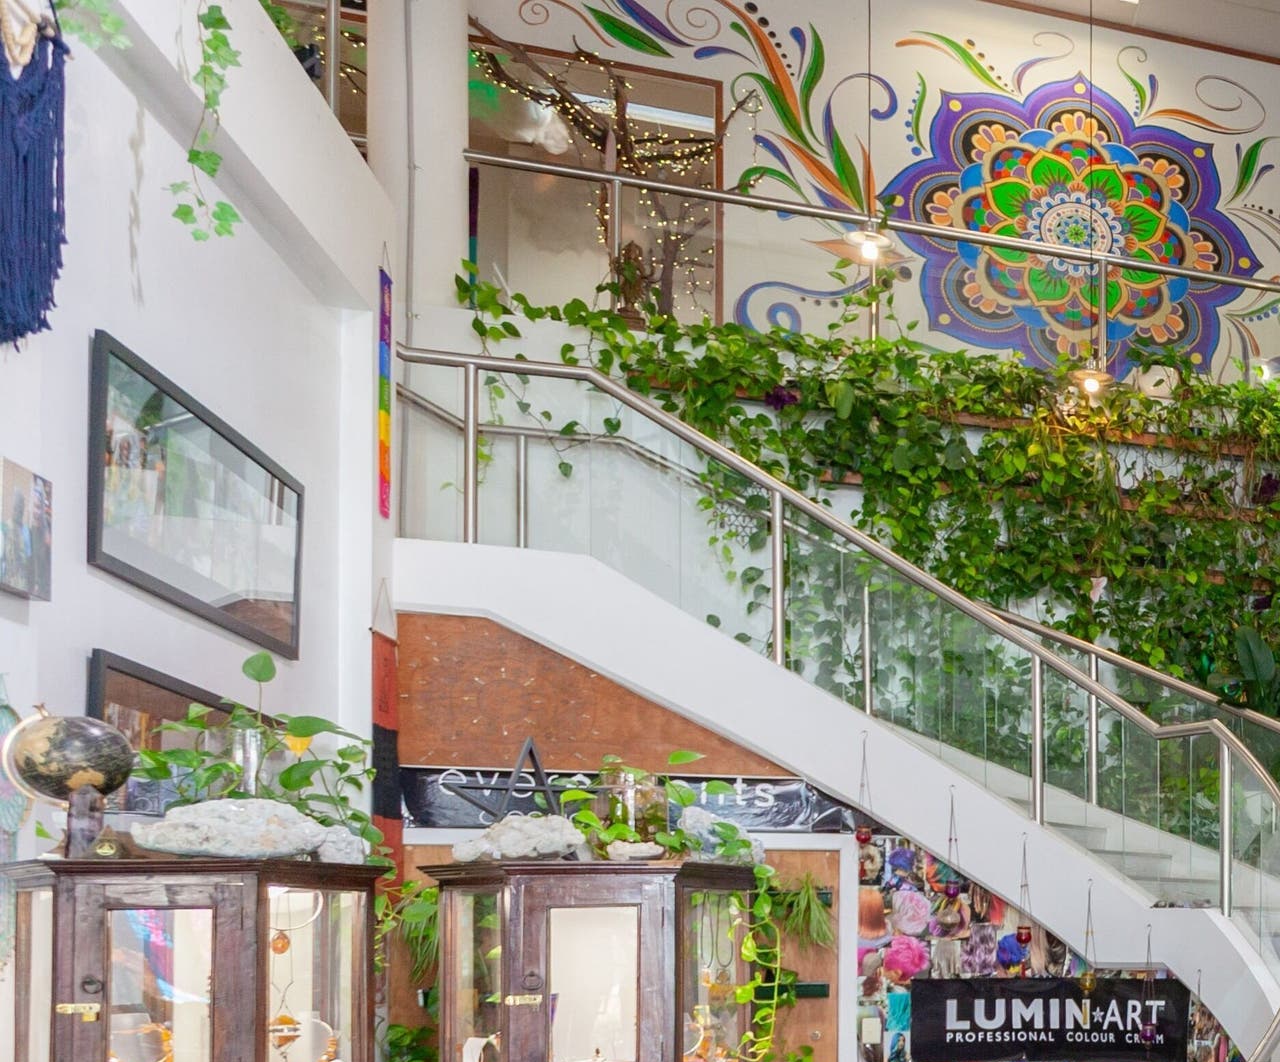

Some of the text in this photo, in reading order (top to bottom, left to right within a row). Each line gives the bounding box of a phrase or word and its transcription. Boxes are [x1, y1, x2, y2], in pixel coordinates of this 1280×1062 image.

[945, 998, 1090, 1030] LUMIN
[946, 1032, 1164, 1044] PROFESSIONAL COLOUR CRM
